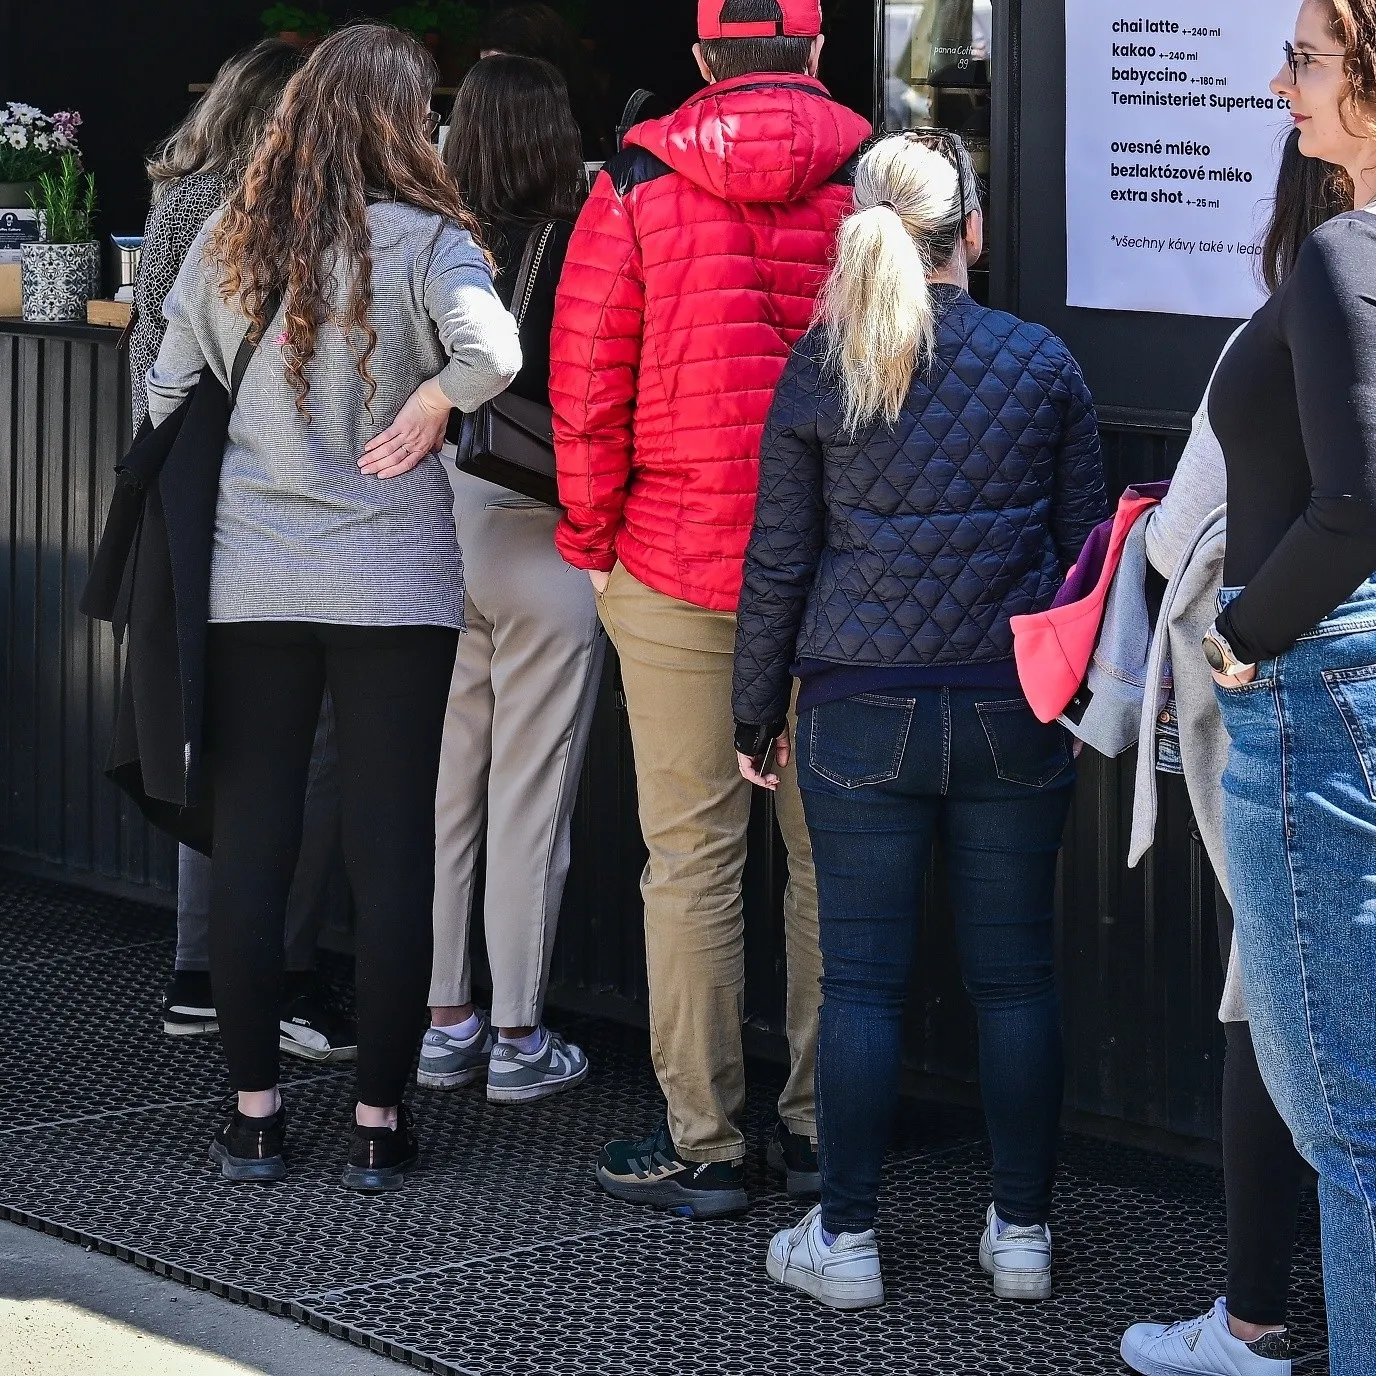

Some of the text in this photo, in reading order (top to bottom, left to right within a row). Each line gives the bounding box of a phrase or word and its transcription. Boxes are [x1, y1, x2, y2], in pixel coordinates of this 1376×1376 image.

[1112, 18, 1142, 33] chai
[1146, 19, 1179, 33] latte
[1209, 28, 1220, 36] ml
[934, 46, 956, 56] panna
[1112, 42, 1156, 57] kakao
[1187, 52, 1198, 60] ml
[1112, 67, 1187, 86] babyccino
[1215, 77, 1226, 86] ml
[1111, 90, 1206, 107] Teministeriet
[1209, 94, 1273, 113] Supertea
[1111, 139, 1210, 156] ovesné mléko
[1111, 163, 1252, 183] bezlaktózové mléko
[1110, 188, 1147, 202] extra
[1151, 189, 1183, 204] shot
[1208, 199, 1219, 208] ml
[1168, 238, 1196, 254] kávy
[1199, 240, 1223, 253] také
[1227, 244, 1234, 253] v
[1236, 242, 1262, 256] ledo
